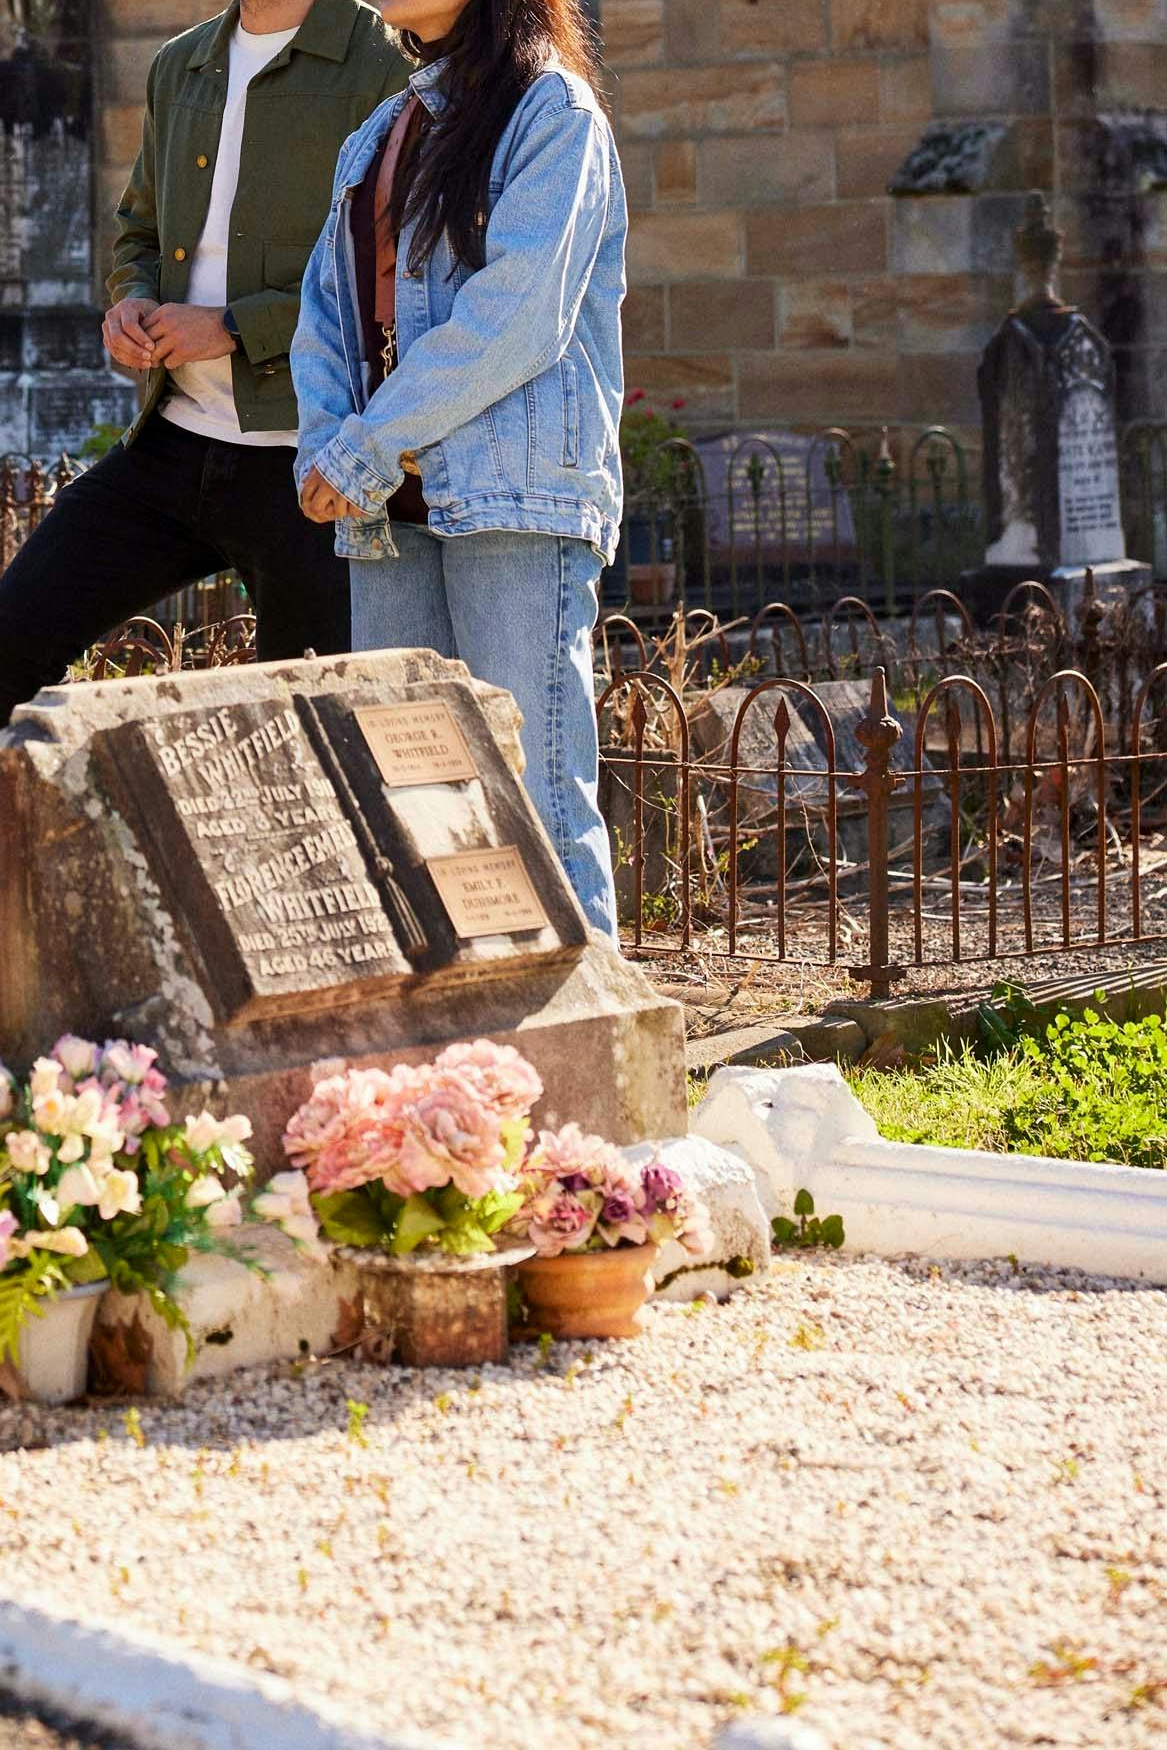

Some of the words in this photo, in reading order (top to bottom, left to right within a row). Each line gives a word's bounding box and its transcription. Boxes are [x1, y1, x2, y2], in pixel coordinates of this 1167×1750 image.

[158, 707, 238, 778] BESSIE
[198, 709, 300, 792] WHITFIELD
[385, 730, 430, 743] GEORGE
[392, 744, 449, 759] WHITFIELD
[176, 796, 219, 816] DIED
[260, 783, 303, 805] JULY
[196, 815, 247, 839] AGED
[273, 803, 343, 828] YEARS
[214, 843, 313, 912] FLORENCE
[462, 878, 493, 892] EMILY
[257, 880, 382, 923] WHITFIELD
[462, 893, 521, 909] DUNSMORE
[237, 932, 277, 951] DIED
[318, 919, 358, 942] JULY
[259, 953, 309, 976] AGED
